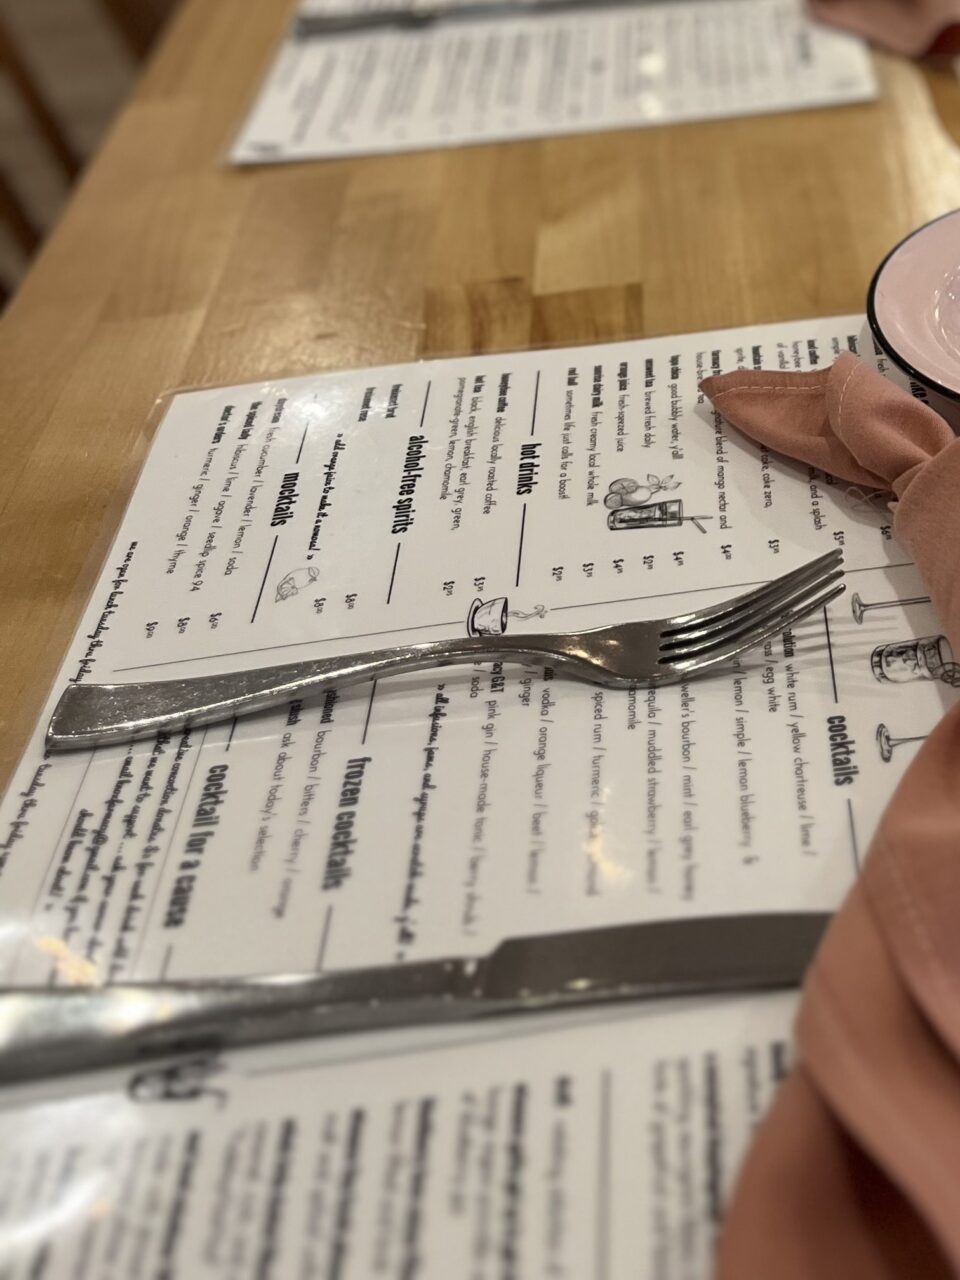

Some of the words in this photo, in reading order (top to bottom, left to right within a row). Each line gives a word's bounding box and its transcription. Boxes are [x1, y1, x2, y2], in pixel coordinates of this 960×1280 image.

[644, 390, 656, 415] brewed
[667, 382, 682, 399] good
[468, 396, 482, 414] black,
[563, 389, 575, 421] sometimes
[667, 399, 683, 421] bubbly
[463, 415, 479, 437] english
[491, 416, 506, 443] delicious
[563, 421, 576, 431] life
[590, 411, 603, 427] fresh
[644, 415, 656, 431] fresh
[264, 426, 280, 443] fresh
[332, 438, 346, 451] add
[560, 432, 572, 445] just
[586, 427, 597, 452] creamy
[615, 437, 624, 452] juice
[641, 432, 656, 448] daily
[670, 422, 681, 444] water,
[715, 434, 728, 455] blend
[199, 447, 218, 476] turmeric
[228, 443, 248, 470] hibiscus
[254, 444, 270, 478] cucumber
[444, 438, 461, 462] lemon,
[459, 438, 477, 471] breakfast,
[486, 443, 504, 464] locally
[519, 442, 542, 461] hot
[560, 445, 574, 460] calls
[588, 452, 600, 468] local
[715, 455, 729, 463] of
[398, 434, 429, 496] alcohol-free
[560, 460, 573, 471] for
[759, 454, 772, 471] coke,
[221, 476, 238, 492] lime
[439, 462, 457, 500] chamomile
[459, 472, 471, 486] earl
[485, 466, 498, 492] roasted
[515, 461, 540, 496] drinks
[586, 469, 599, 490] whole
[713, 464, 725, 490] mango
[762, 472, 775, 489] coke
[188, 483, 204, 507] ginger
[242, 484, 263, 517] lavender
[269, 471, 300, 527] mocktails
[322, 486, 335, 494] to
[452, 487, 465, 506] grey,
[586, 492, 599, 506] milk
[718, 491, 729, 512] nectar
[763, 490, 773, 508] zero,
[809, 482, 823, 499] and
[212, 500, 226, 523] agave
[317, 494, 332, 512] make
[482, 492, 497, 515] coffee
[175, 514, 193, 541] orange
[390, 497, 416, 534] spirits
[450, 507, 462, 531] green,
[719, 514, 732, 530] and
[809, 507, 827, 531] splash
[128, 541, 138, 551] we
[198, 531, 217, 558] seedlip
[232, 524, 252, 549] lemon
[123, 551, 134, 563] are
[165, 549, 186, 574] thyme
[193, 559, 207, 579] spice
[223, 556, 239, 576] soda
[115, 563, 129, 579] open
[111, 578, 128, 591] for
[189, 580, 204, 592] 94
[104, 590, 124, 610] lunch
[86, 610, 115, 640] tuesday
[66, 657, 97, 685] friday
[783, 662, 801, 689] white
[468, 675, 485, 698] soda
[489, 675, 505, 694] G&T
[517, 677, 533, 708] ginger
[730, 675, 748, 706] lemon
[759, 665, 775, 684] egg
[767, 686, 782, 713] white
[433, 690, 451, 705] all
[484, 699, 501, 720] pink
[540, 687, 556, 716] vodka
[590, 688, 610, 720] spiced
[679, 683, 695, 718] weller's
[787, 691, 798, 711] rum
[284, 703, 305, 726] slush
[280, 732, 296, 748] ask
[480, 722, 496, 738] gin
[592, 723, 602, 744] rum
[680, 720, 696, 763] bourbon
[732, 716, 751, 747] simple
[786, 721, 807, 754] yellow
[308, 729, 332, 773] bourbon
[532, 726, 548, 761] orange
[647, 729, 662, 774] muddled
[826, 715, 859, 786] cocktails
[272, 751, 292, 781] about
[590, 754, 605, 798] turmeric
[737, 758, 753, 791] lemon
[159, 761, 181, 807] concoction
[338, 756, 372, 808] frozen
[420, 772, 437, 791] and
[475, 748, 497, 813] house-made
[531, 763, 552, 799] liqueur
[682, 774, 695, 798] mint
[793, 756, 809, 811] chartreuse
[134, 790, 151, 804] to
[191, 764, 229, 828] cocktail
[259, 784, 283, 822] today's
[297, 783, 320, 816] bitters
[121, 804, 141, 839] support
[146, 806, 172, 844] donates
[183, 830, 215, 855] for
[321, 810, 357, 891] cocktails
[178, 859, 201, 871] a
[162, 874, 196, 928] cause
